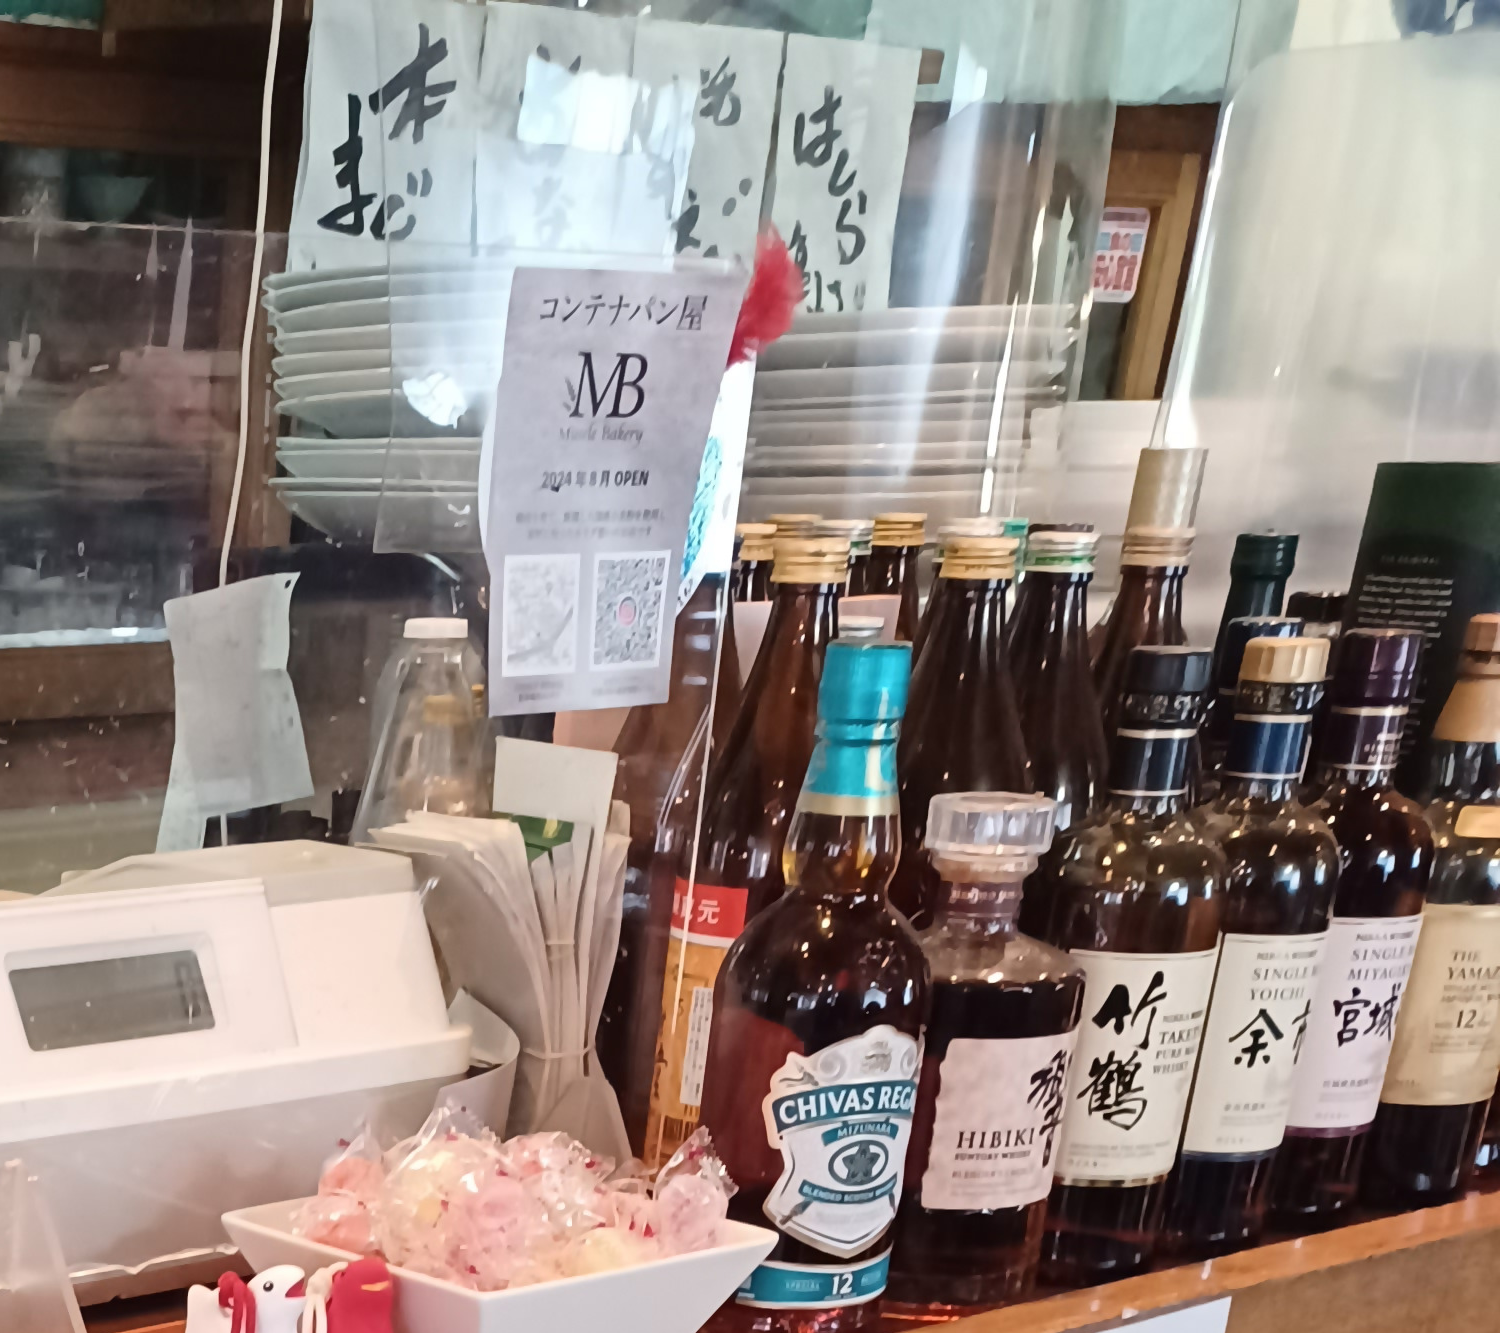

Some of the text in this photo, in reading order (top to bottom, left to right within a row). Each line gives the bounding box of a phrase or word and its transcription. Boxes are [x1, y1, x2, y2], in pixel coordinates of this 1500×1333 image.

[539, 294, 708, 331] コンテナパン屋
[614, 469, 650, 487] OPEN
[1250, 985, 1305, 1001] YOICHI
[1456, 1008, 1477, 1029] 12
[1077, 970, 1168, 1131] 竹鶴
[779, 1086, 876, 1125] CHIVAS
[836, 1122, 892, 1139] MIZUNARA
[956, 1127, 1035, 1150] HIBIKI
[831, 1273, 854, 1295] 12
